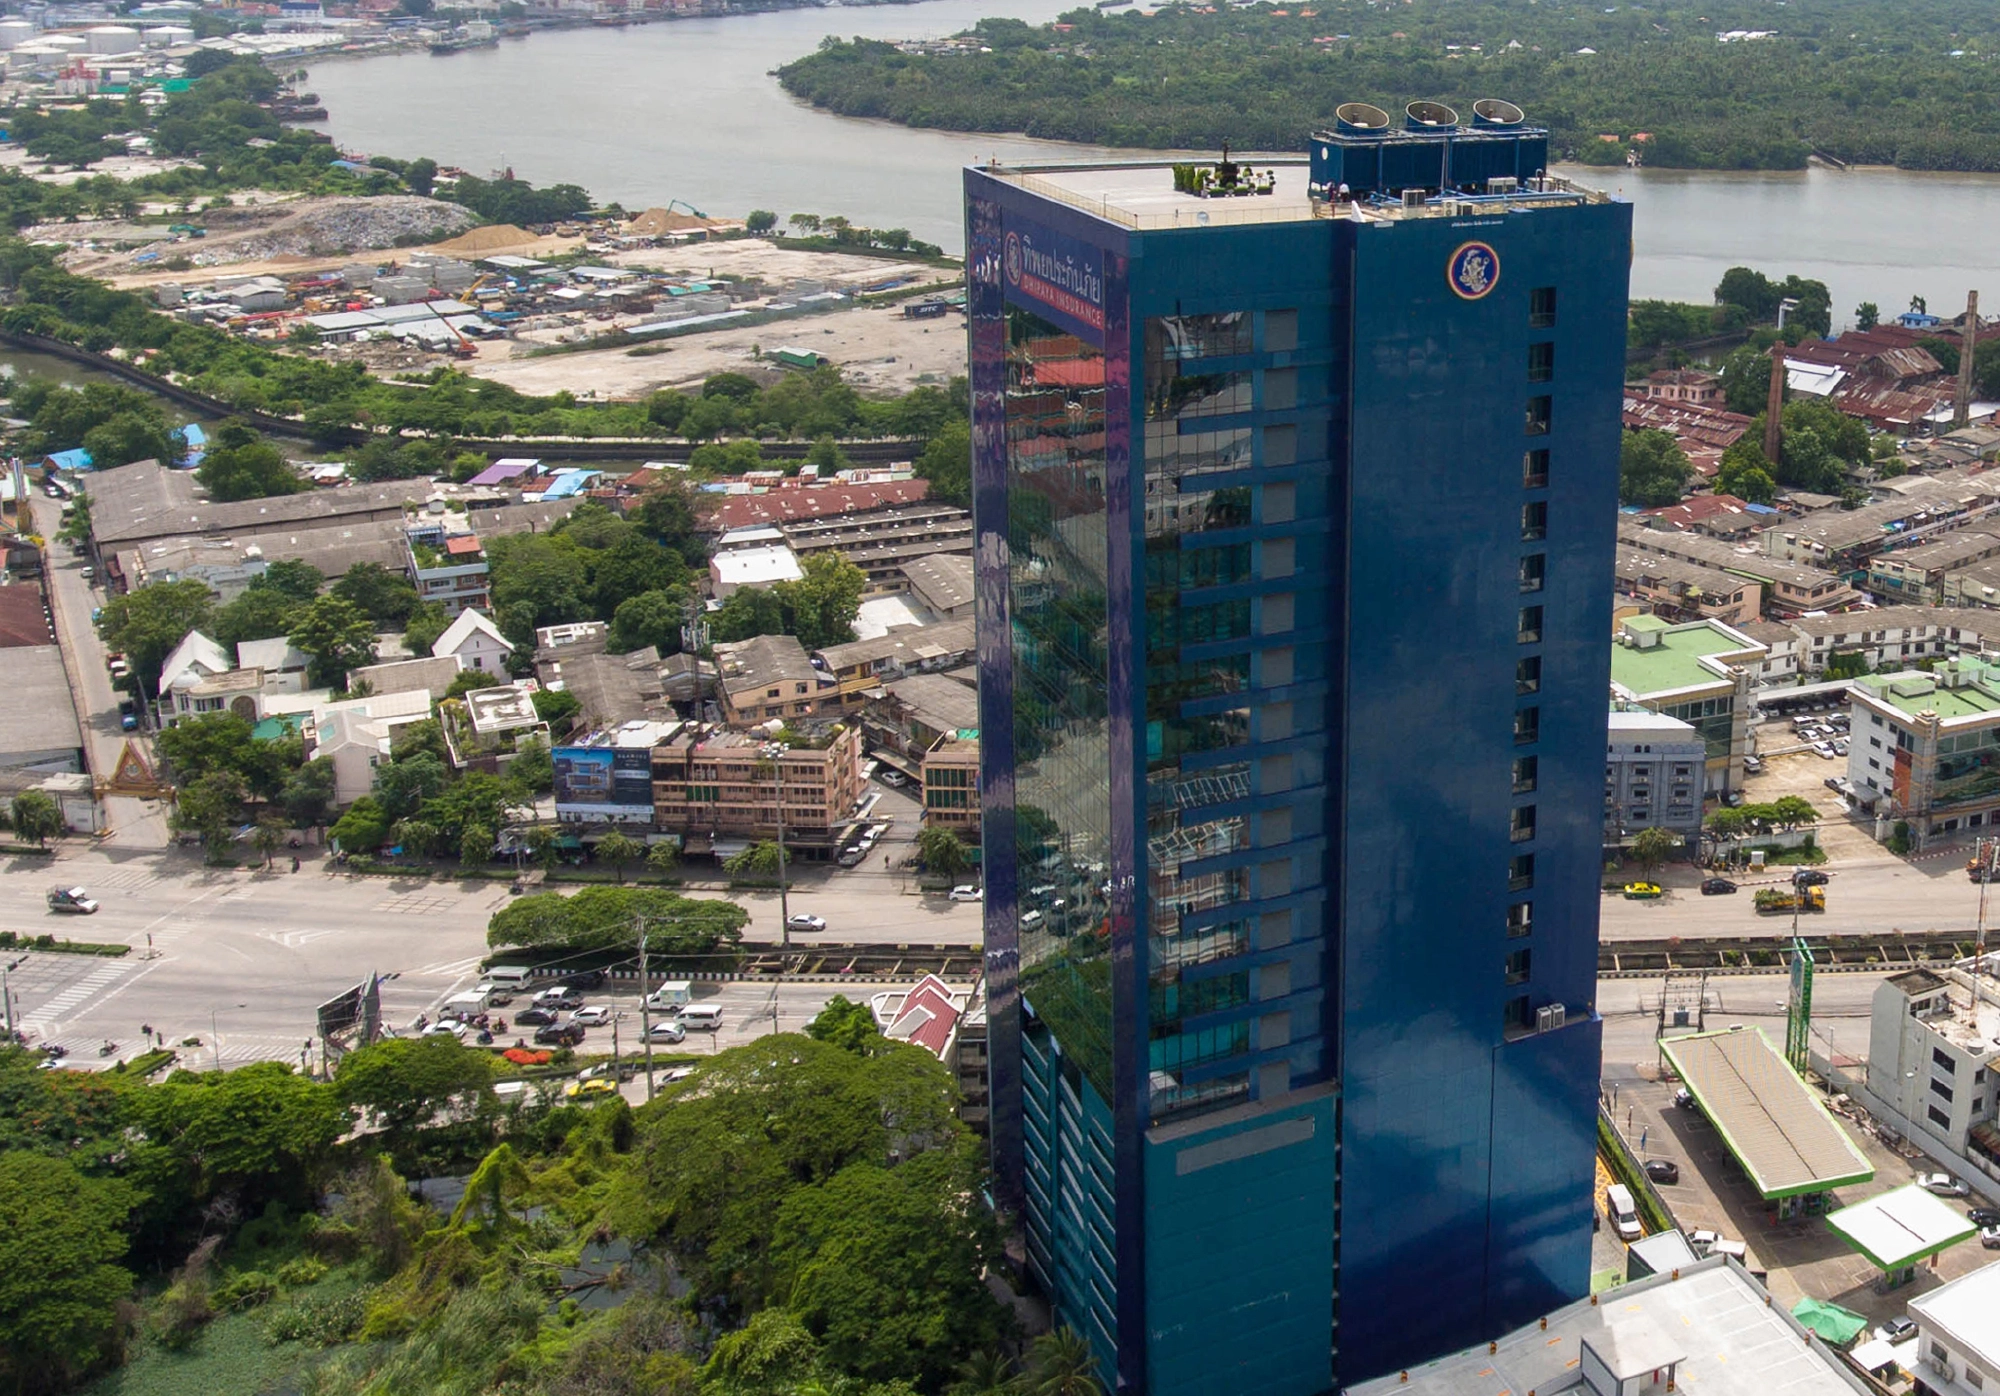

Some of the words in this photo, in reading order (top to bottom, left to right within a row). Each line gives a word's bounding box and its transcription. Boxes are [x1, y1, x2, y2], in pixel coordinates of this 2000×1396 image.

[1022, 234, 1101, 303] ทิพยประกันภัย
[1024, 275, 1055, 302] DHIPAYA
[1056, 290, 1101, 325] INSURANCE
